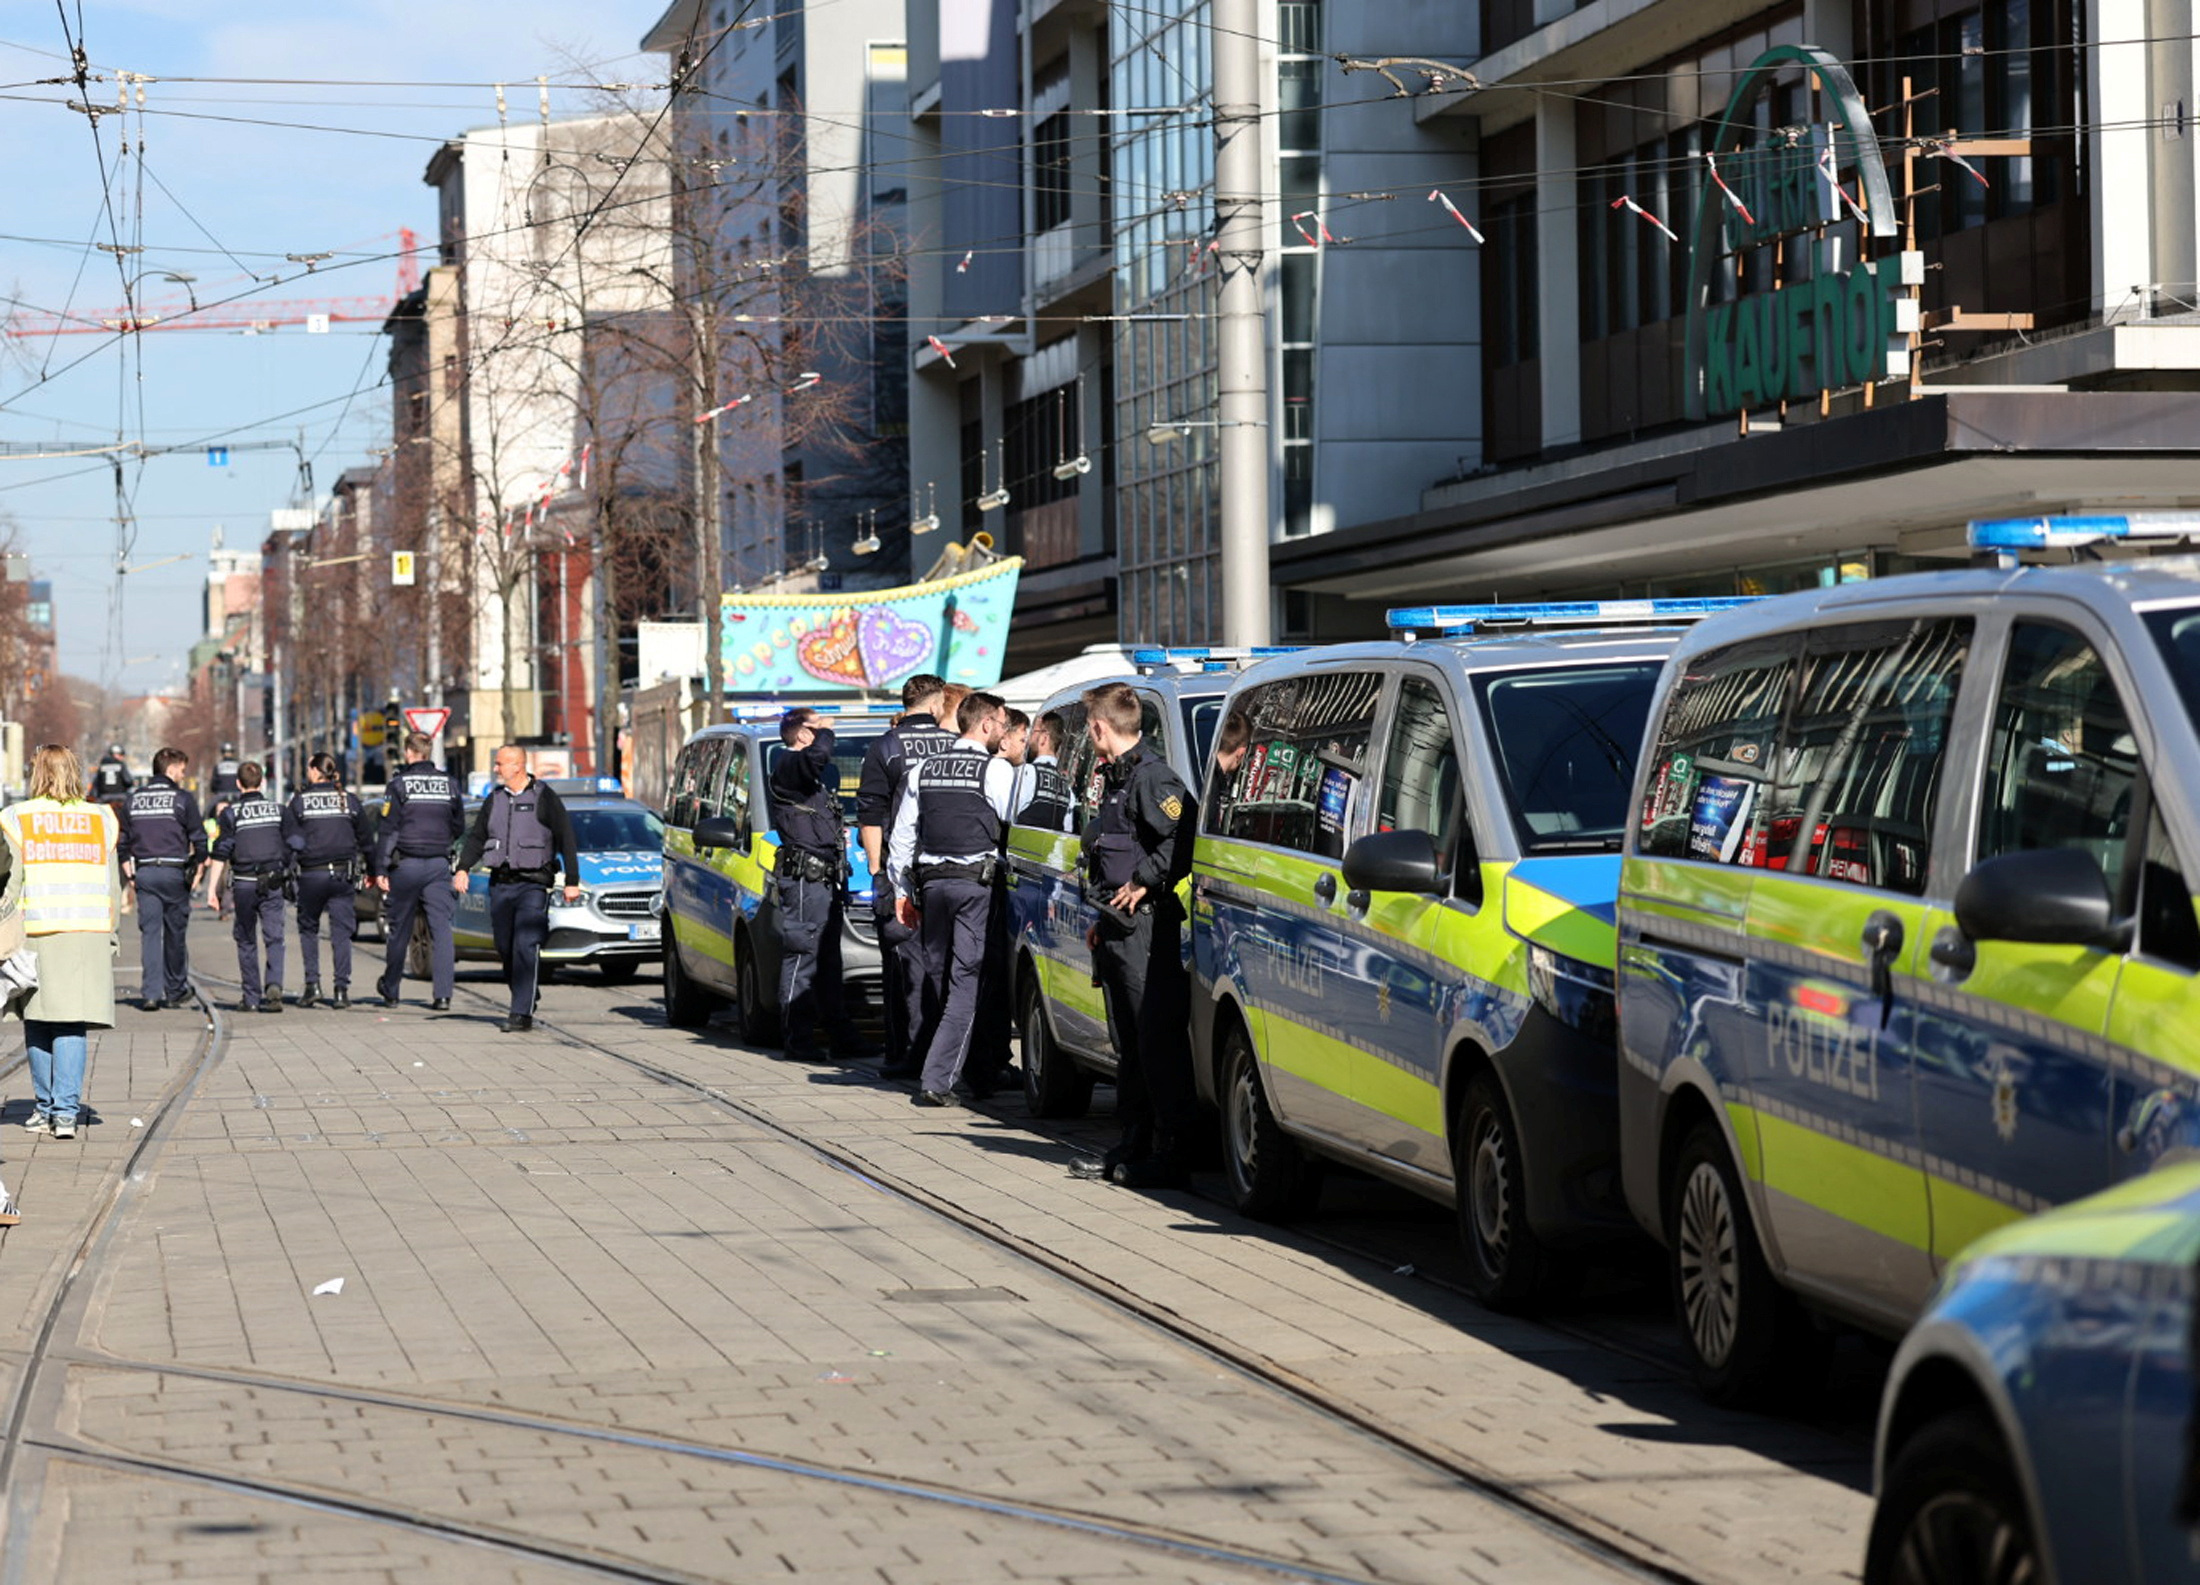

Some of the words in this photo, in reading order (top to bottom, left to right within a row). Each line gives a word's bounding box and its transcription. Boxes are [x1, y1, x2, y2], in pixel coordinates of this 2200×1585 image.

[922, 760, 981, 778] POLIZEI
[405, 780, 449, 794] POLIZEI
[131, 796, 174, 809] POLIZEI
[32, 812, 92, 835] POLIZEI
[24, 839, 101, 863] Betreuung
[1267, 936, 1323, 999] POLIZEI
[1768, 1000, 1878, 1101] POLIZEI
